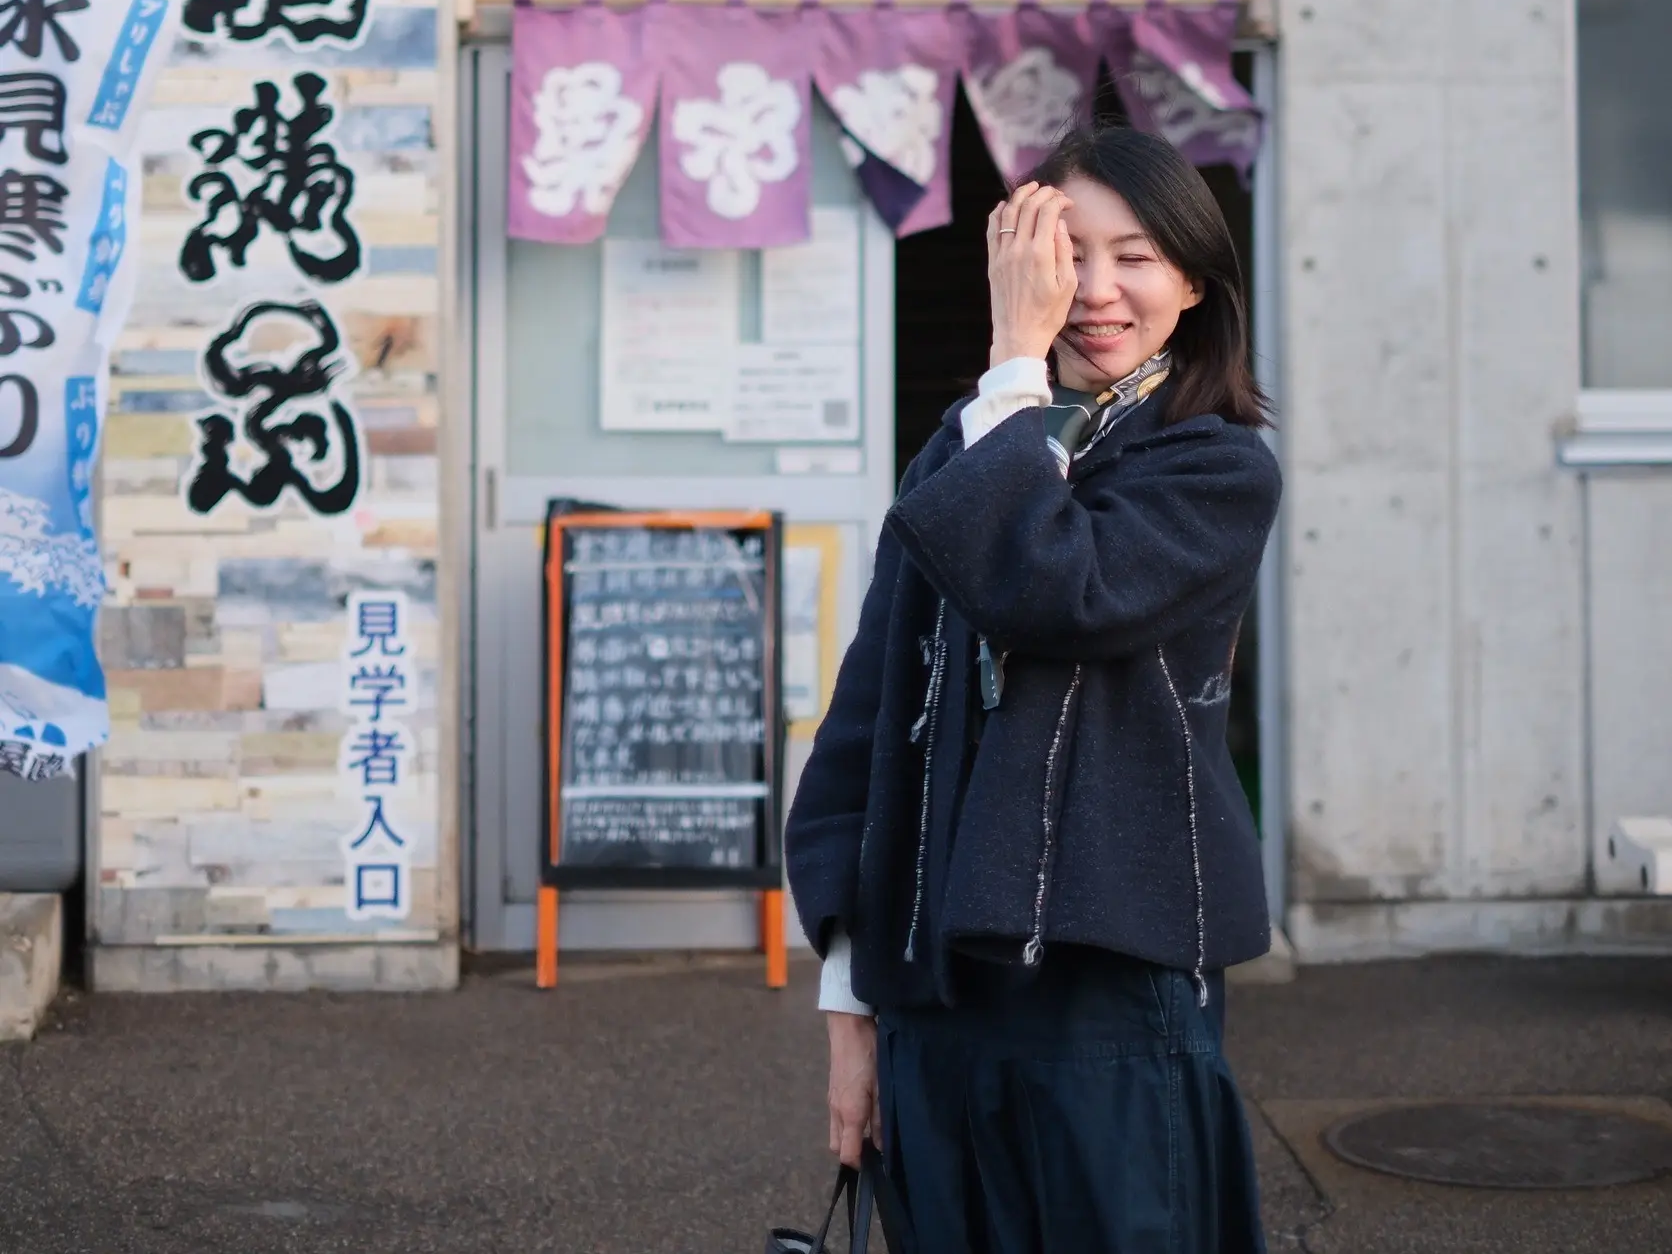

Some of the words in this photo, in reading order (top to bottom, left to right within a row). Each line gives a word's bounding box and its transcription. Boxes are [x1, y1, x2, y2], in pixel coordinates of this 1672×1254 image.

[347, 599, 407, 909] 見学者入口
